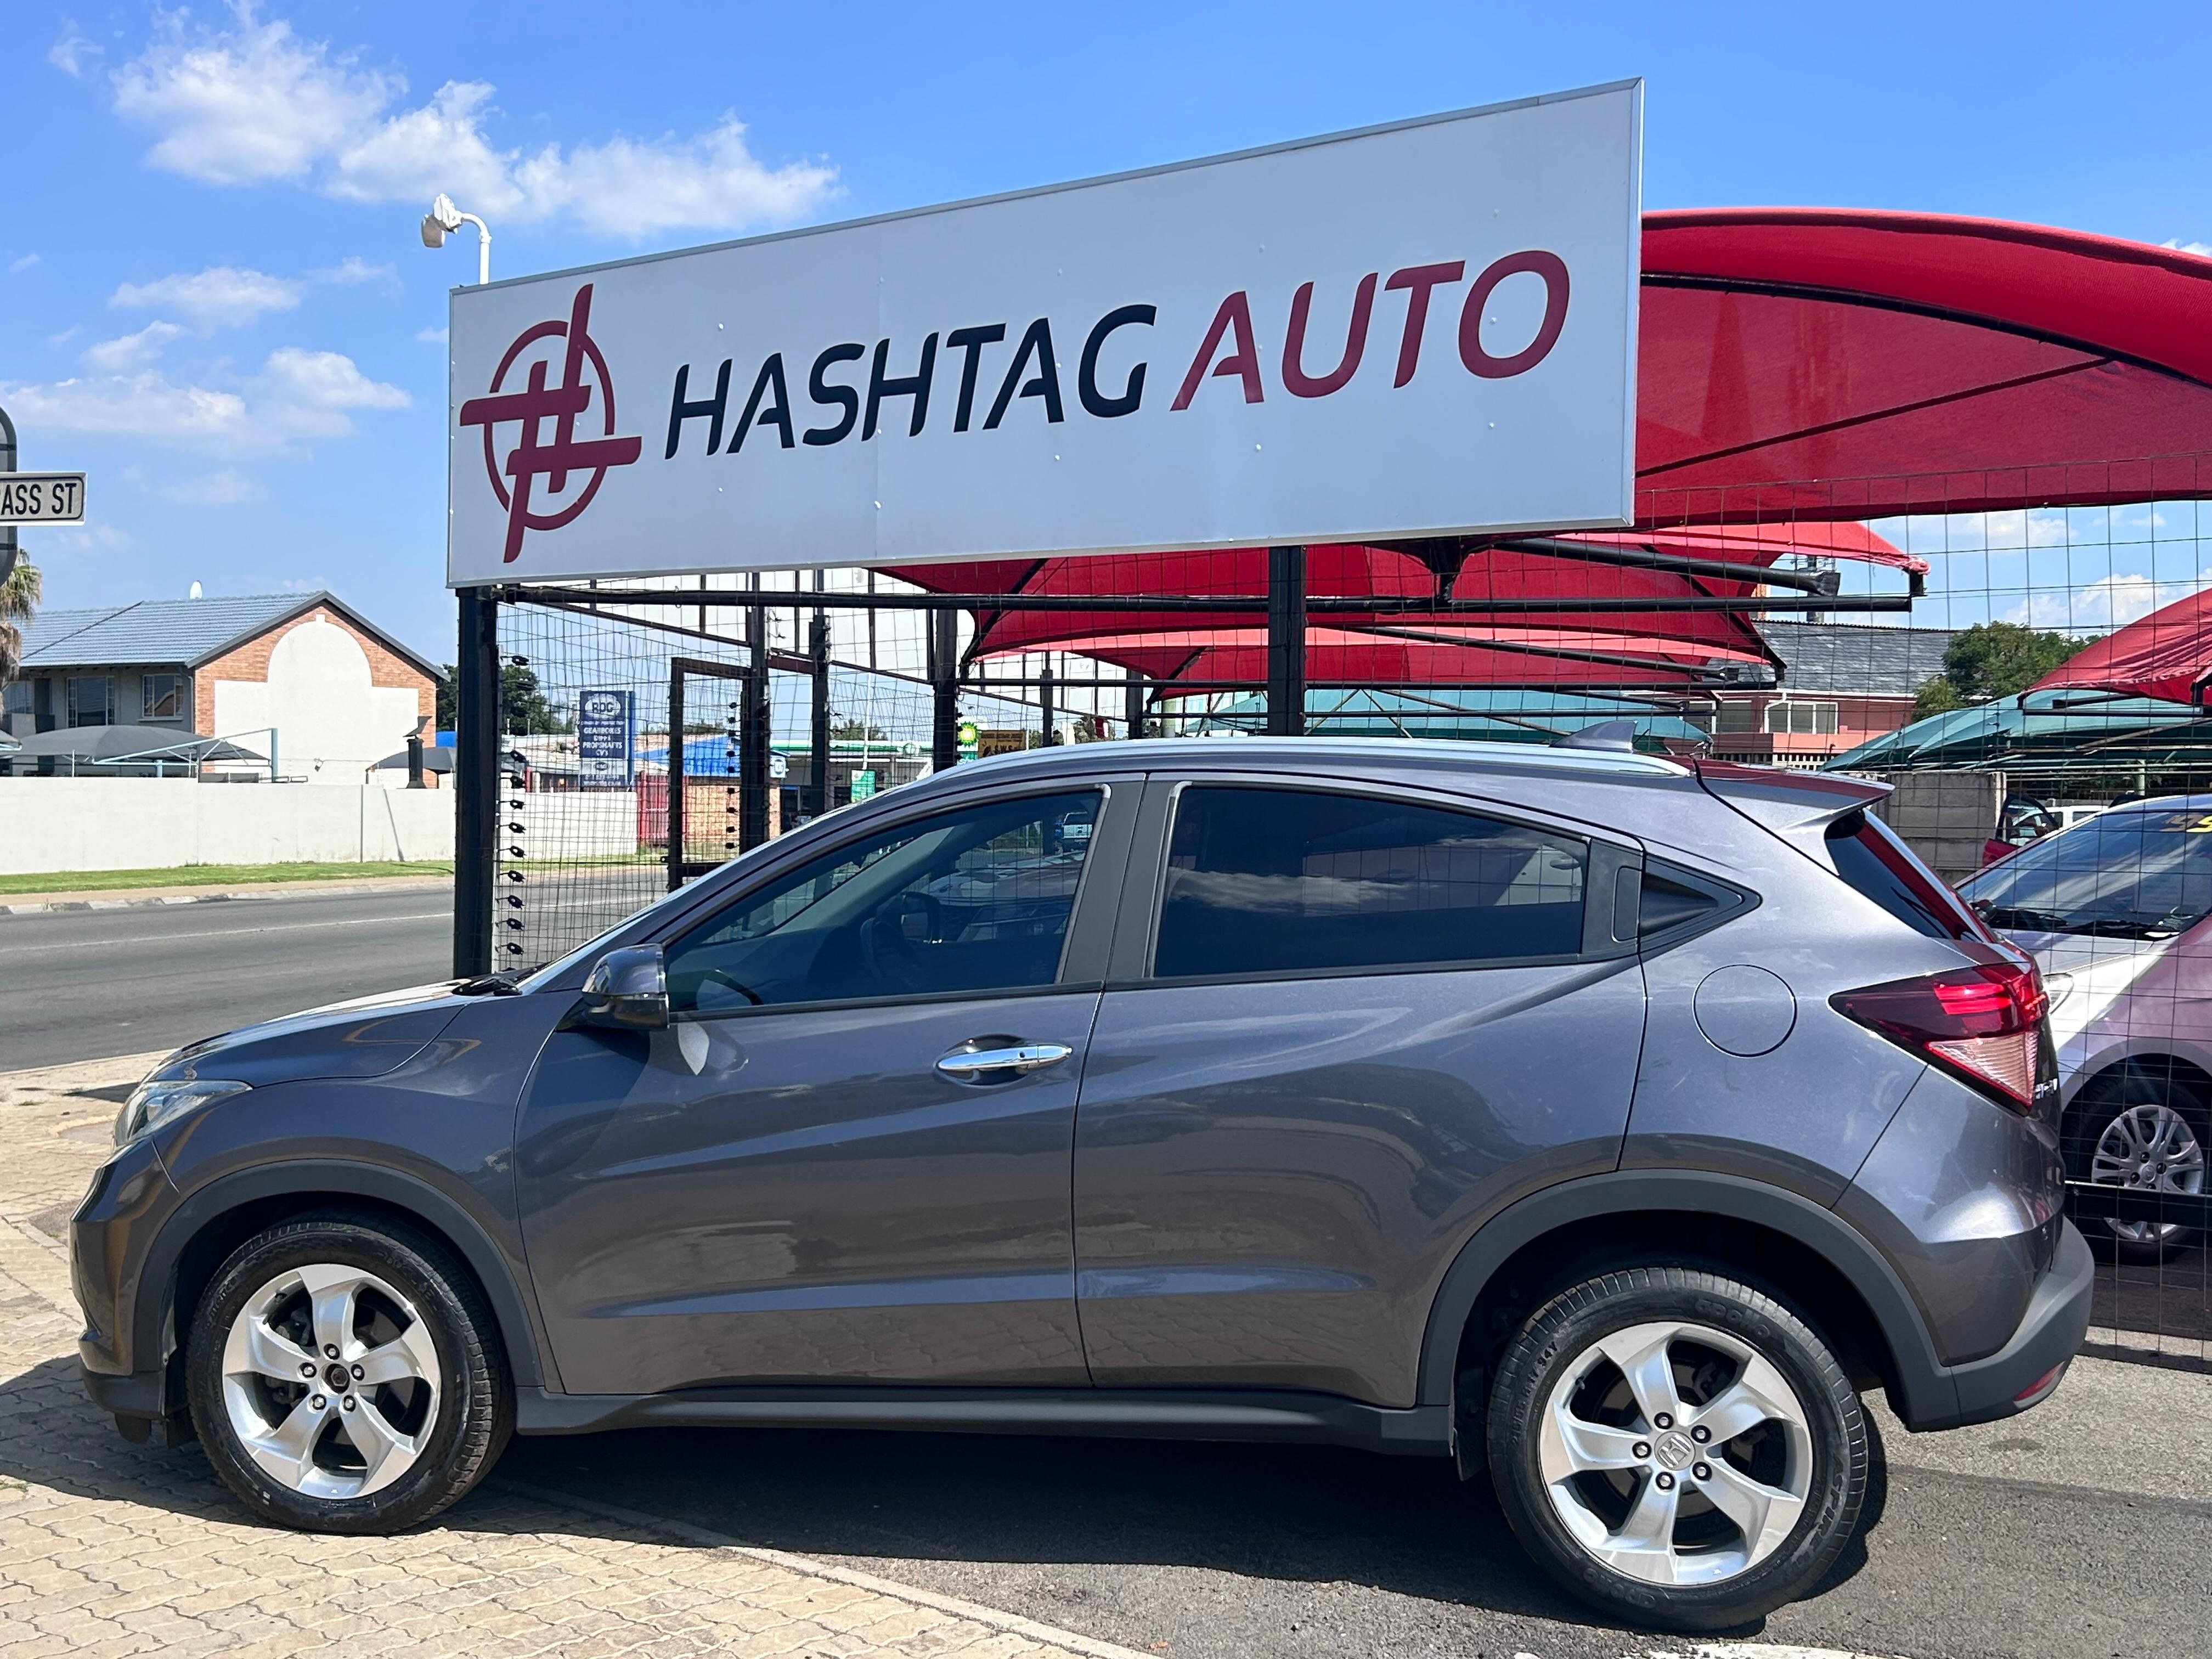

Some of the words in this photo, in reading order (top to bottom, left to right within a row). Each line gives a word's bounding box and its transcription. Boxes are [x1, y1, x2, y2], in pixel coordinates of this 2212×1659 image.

[664, 304, 1157, 460] HASHTAG
[1170, 250, 1570, 411] AUTO
[0, 484, 41, 515] ASS
[52, 483, 77, 514] ST
[1695, 1299, 1770, 1339] apollo
